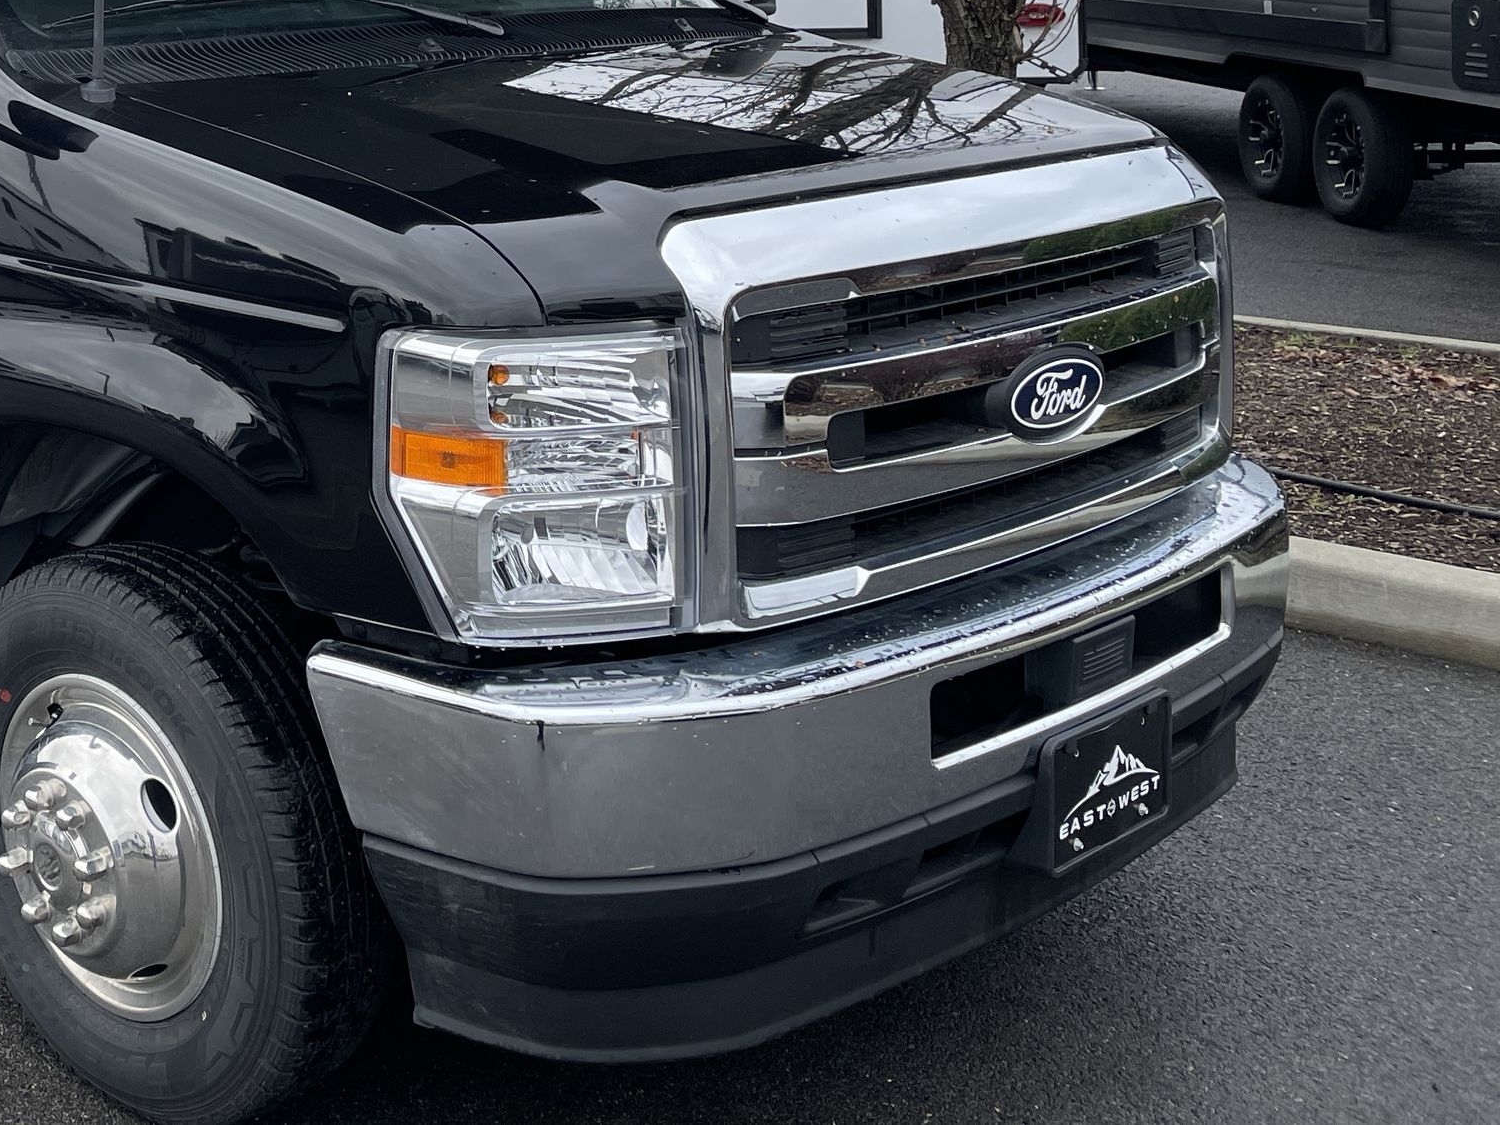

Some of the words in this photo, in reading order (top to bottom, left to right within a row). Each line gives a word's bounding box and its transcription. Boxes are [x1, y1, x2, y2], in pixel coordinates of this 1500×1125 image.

[1030, 368, 1087, 420] Ford
[1059, 804, 1107, 841] EAST
[1119, 775, 1160, 810] WEST
